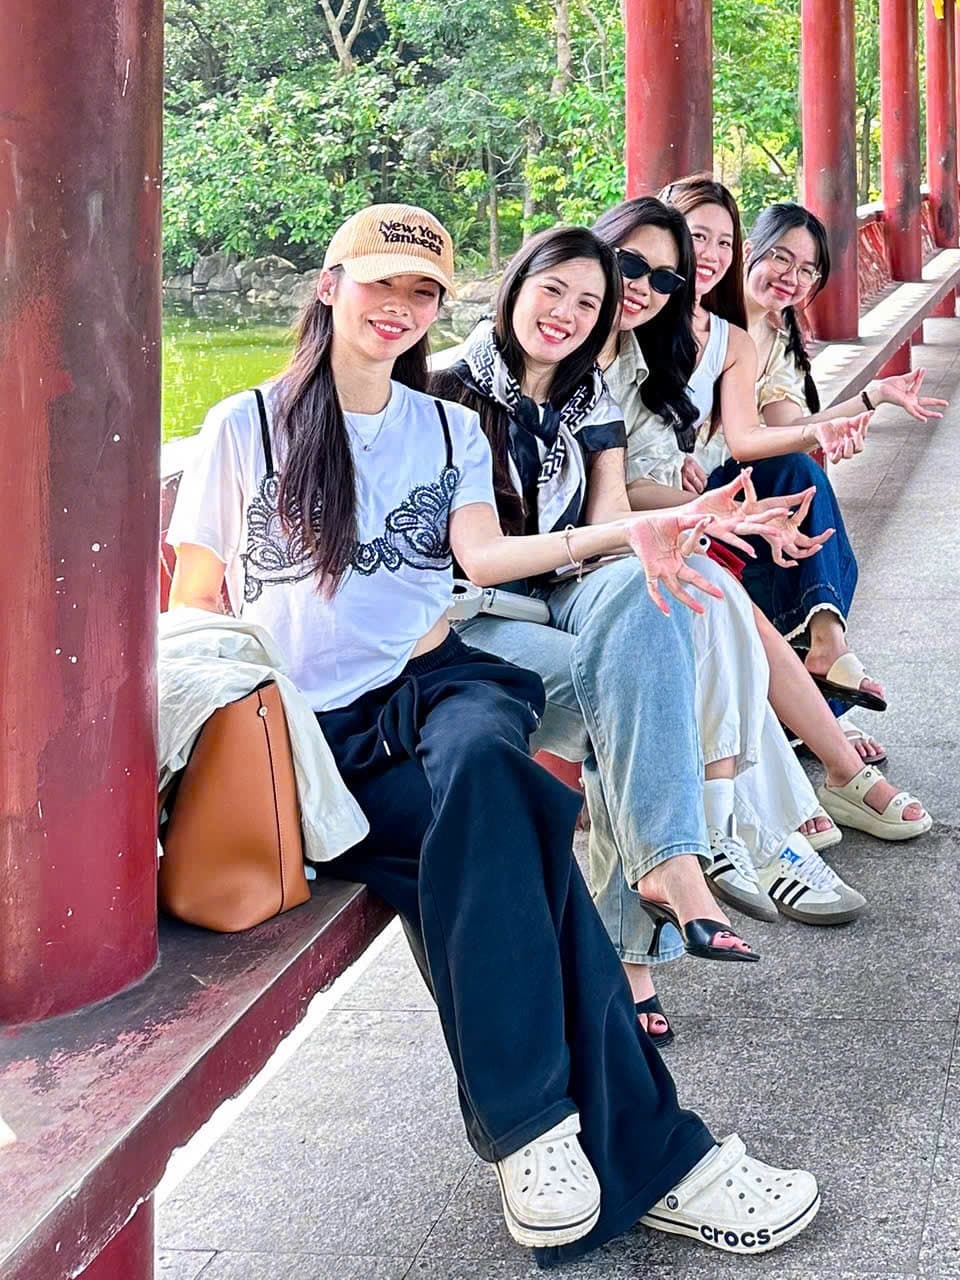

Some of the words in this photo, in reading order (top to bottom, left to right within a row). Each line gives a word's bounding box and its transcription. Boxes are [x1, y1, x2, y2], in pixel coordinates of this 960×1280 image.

[379, 220, 416, 233] New
[381, 231, 442, 256] Yankees
[700, 1225, 771, 1247] crocs
